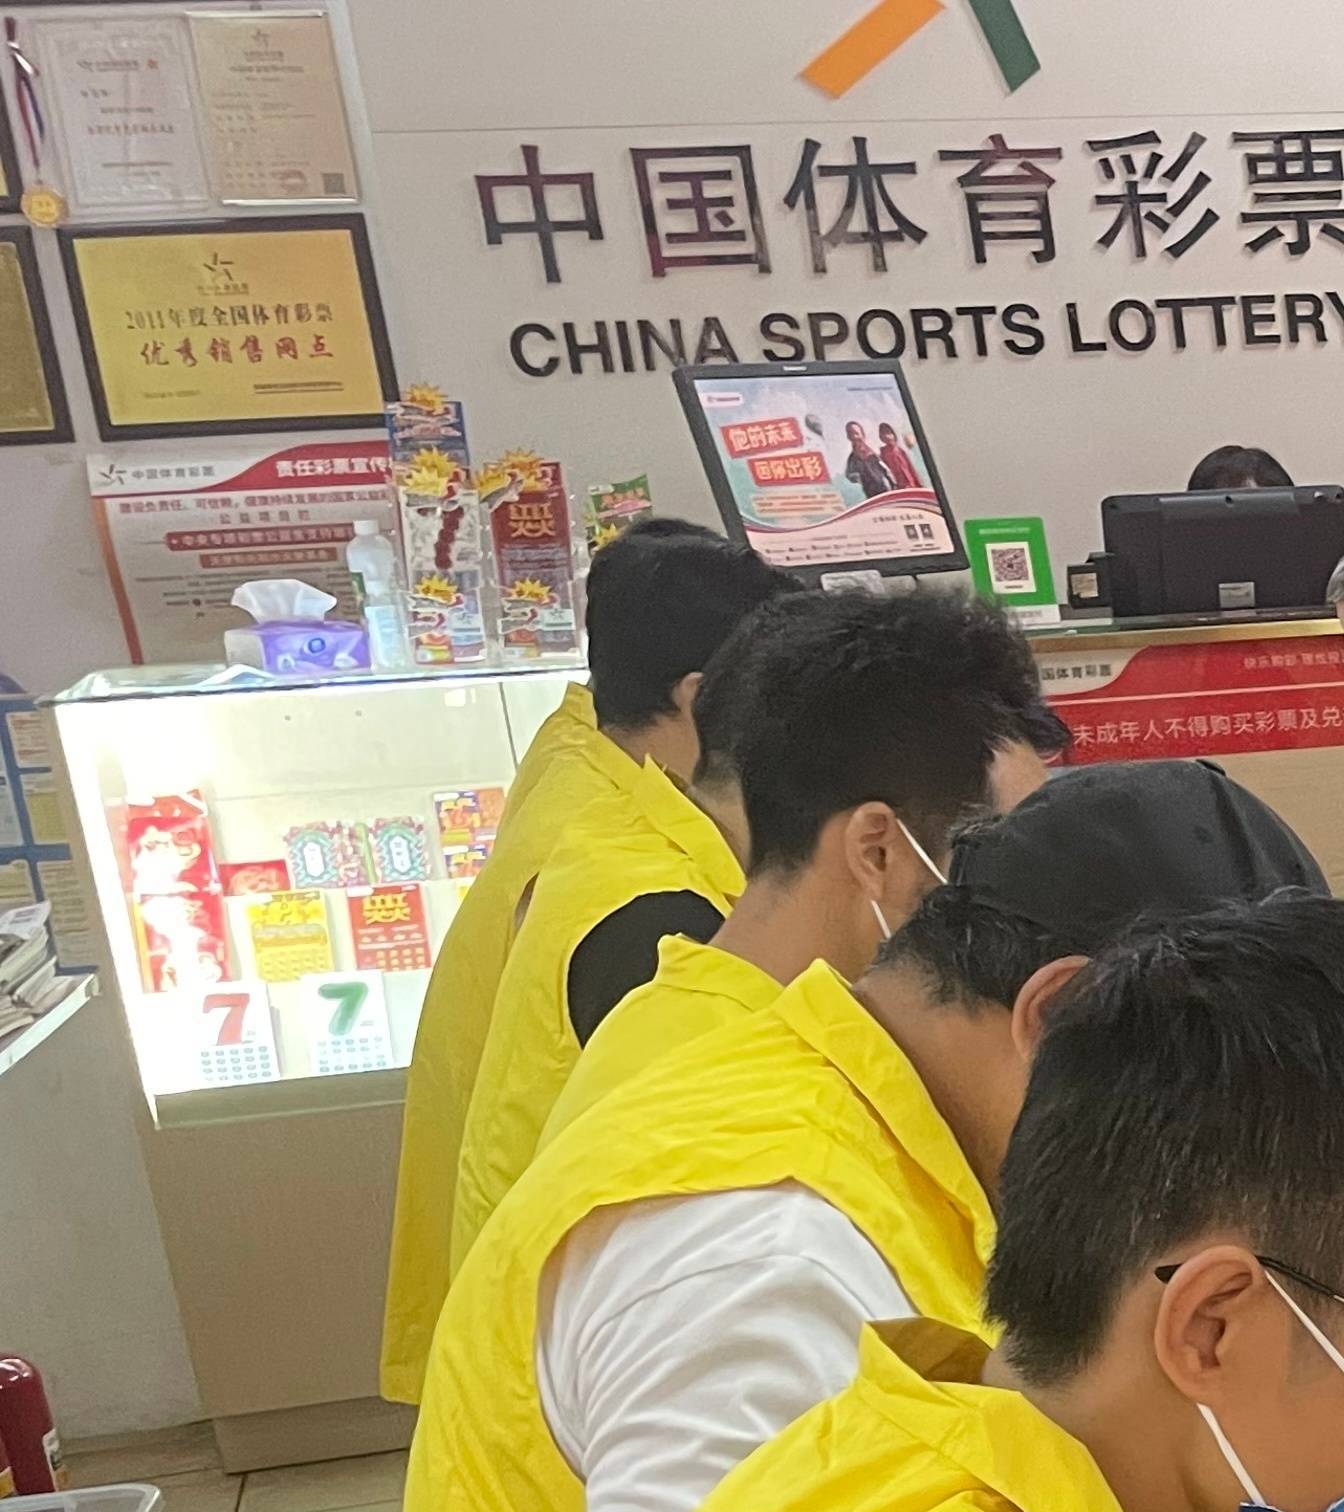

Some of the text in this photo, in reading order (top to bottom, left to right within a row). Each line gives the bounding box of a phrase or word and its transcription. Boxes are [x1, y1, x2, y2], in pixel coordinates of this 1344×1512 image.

[140, 333, 335, 367] 优秀销售网点
[508, 316, 738, 380] CHINA
[760, 303, 1047, 362] SPORTS
[317, 981, 369, 1036] 7
